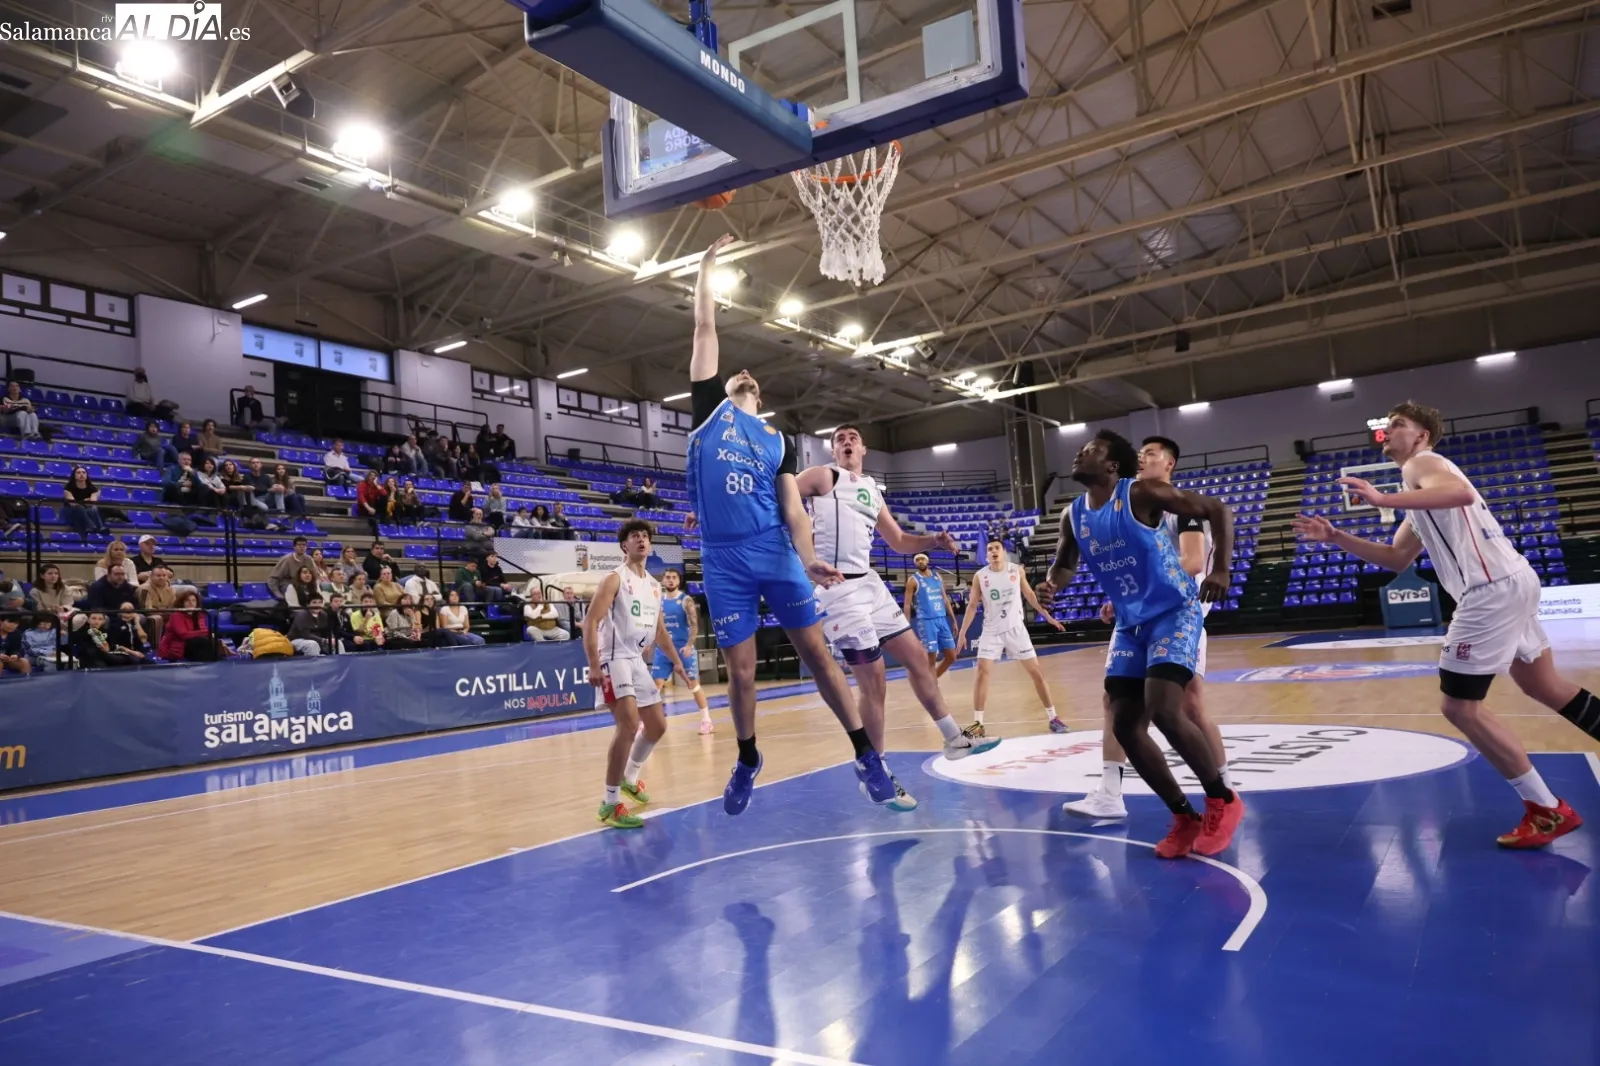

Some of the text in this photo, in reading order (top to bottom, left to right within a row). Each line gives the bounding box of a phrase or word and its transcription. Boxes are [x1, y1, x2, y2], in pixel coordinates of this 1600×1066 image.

[700, 49, 745, 94] MONDO
[726, 472, 754, 495] 80
[1115, 573, 1139, 596] 33
[1000, 609, 1007, 618] 3
[455, 666, 591, 697] CASTILLA Y LE
[504, 692, 577, 712] NOS IMPULSA
[204, 710, 253, 726] turismo
